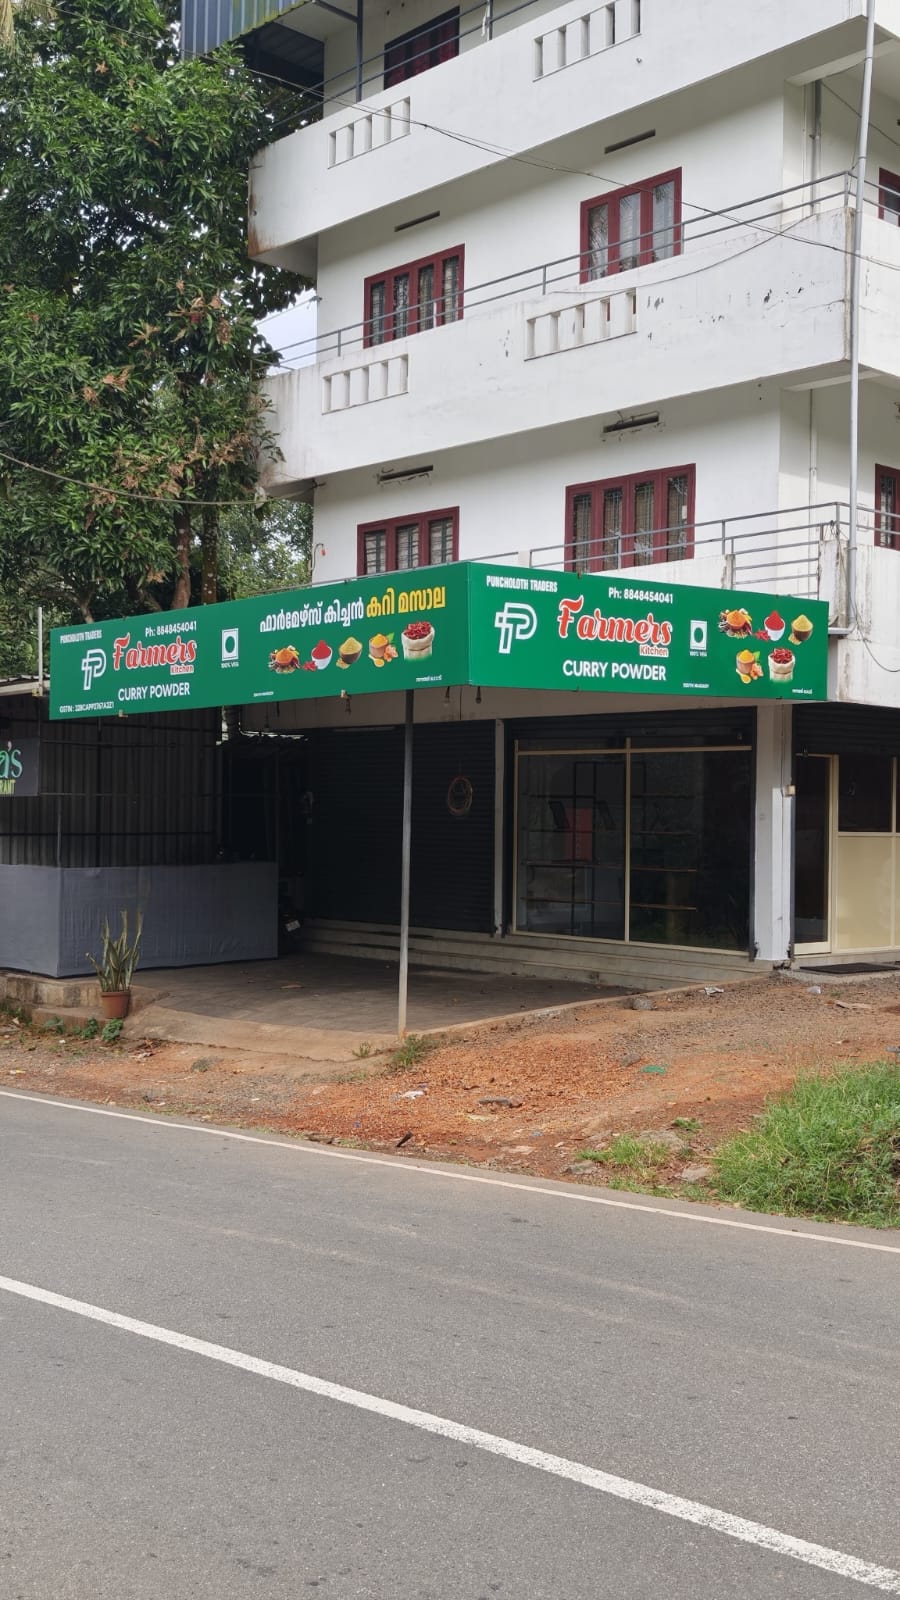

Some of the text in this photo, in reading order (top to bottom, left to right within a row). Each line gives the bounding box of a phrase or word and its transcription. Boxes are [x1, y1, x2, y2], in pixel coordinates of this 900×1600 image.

[486, 575, 558, 593] PUNCHOLOTH TRADERS
[608, 587, 674, 604] Ph: 8848454041
[324, 597, 365, 627] കിച്ചൻ
[366, 587, 395, 618] കറി
[398, 586, 446, 613] മസാല
[145, 620, 197, 638] Ph: 8848454041
[556, 594, 674, 646] Farmers
[84, 629, 102, 640] TRADERS
[112, 631, 198, 672] Farmers
[639, 643, 670, 657] Kitchen
[562, 659, 667, 680] CURRY POWDER
[117, 682, 190, 701] CURRY POWDER
